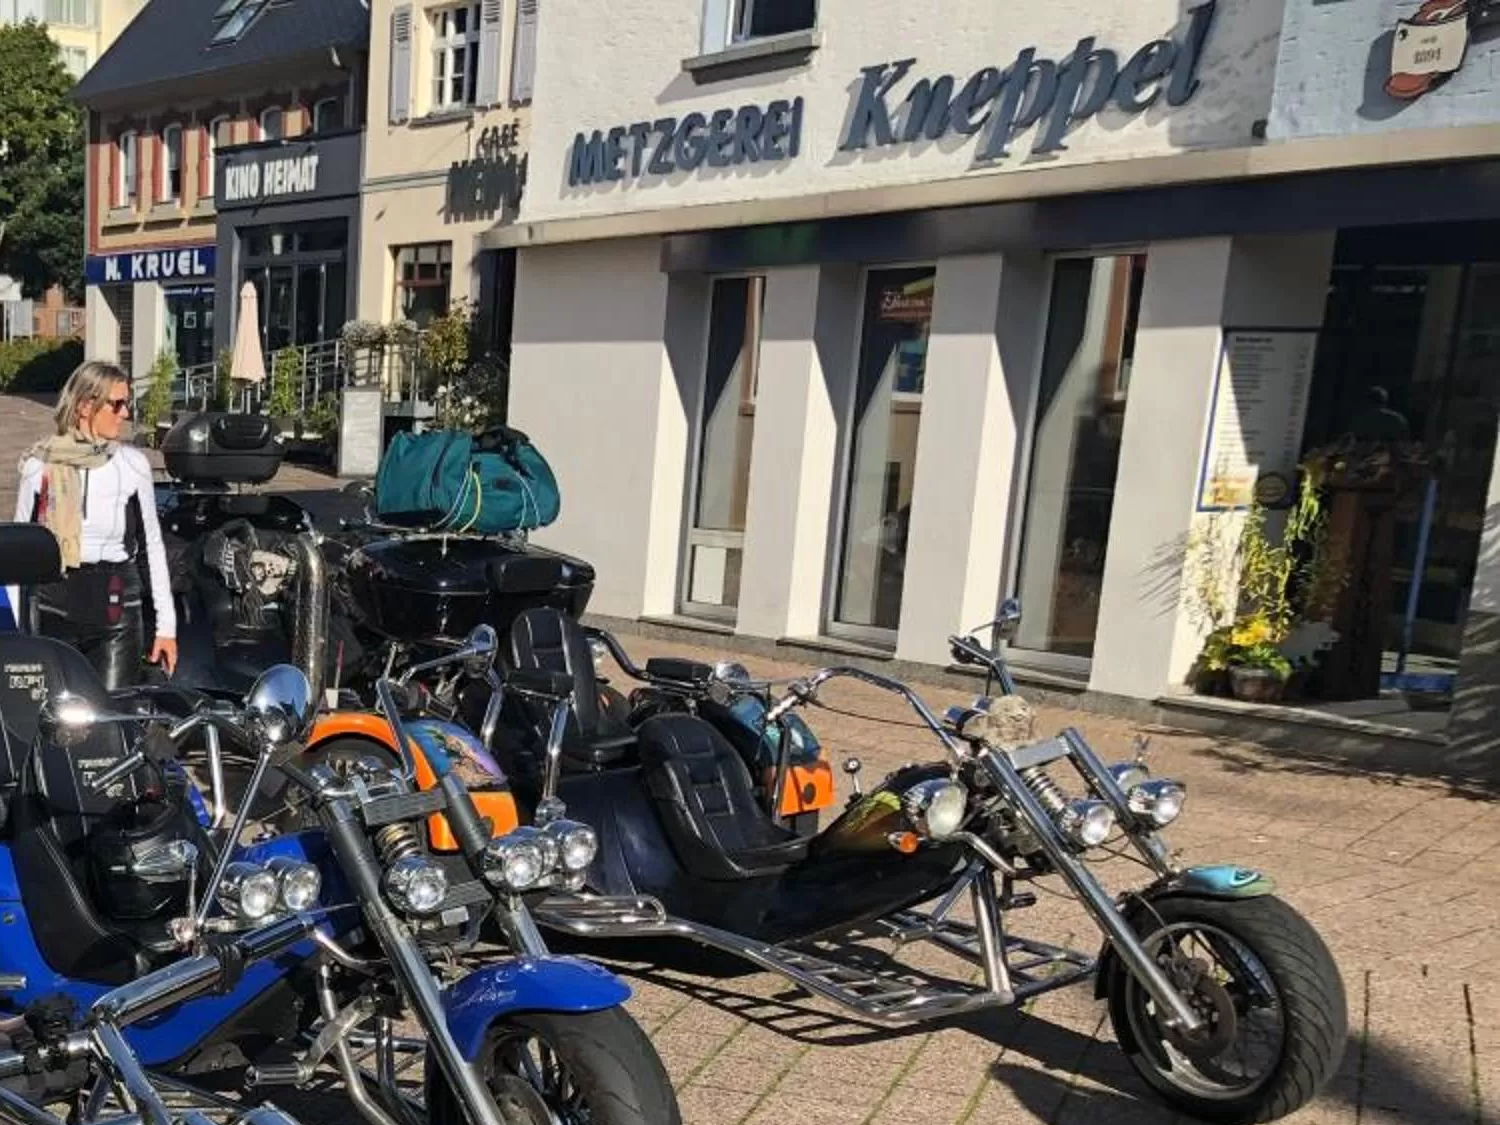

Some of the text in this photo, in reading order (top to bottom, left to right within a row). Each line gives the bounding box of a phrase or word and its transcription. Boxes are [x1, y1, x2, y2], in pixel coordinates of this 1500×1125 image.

[568, 2, 1216, 187] METZGEREI Kneppel
[225, 155, 319, 201] KINO HEIMAT
[131, 249, 206, 279] KRUEL
